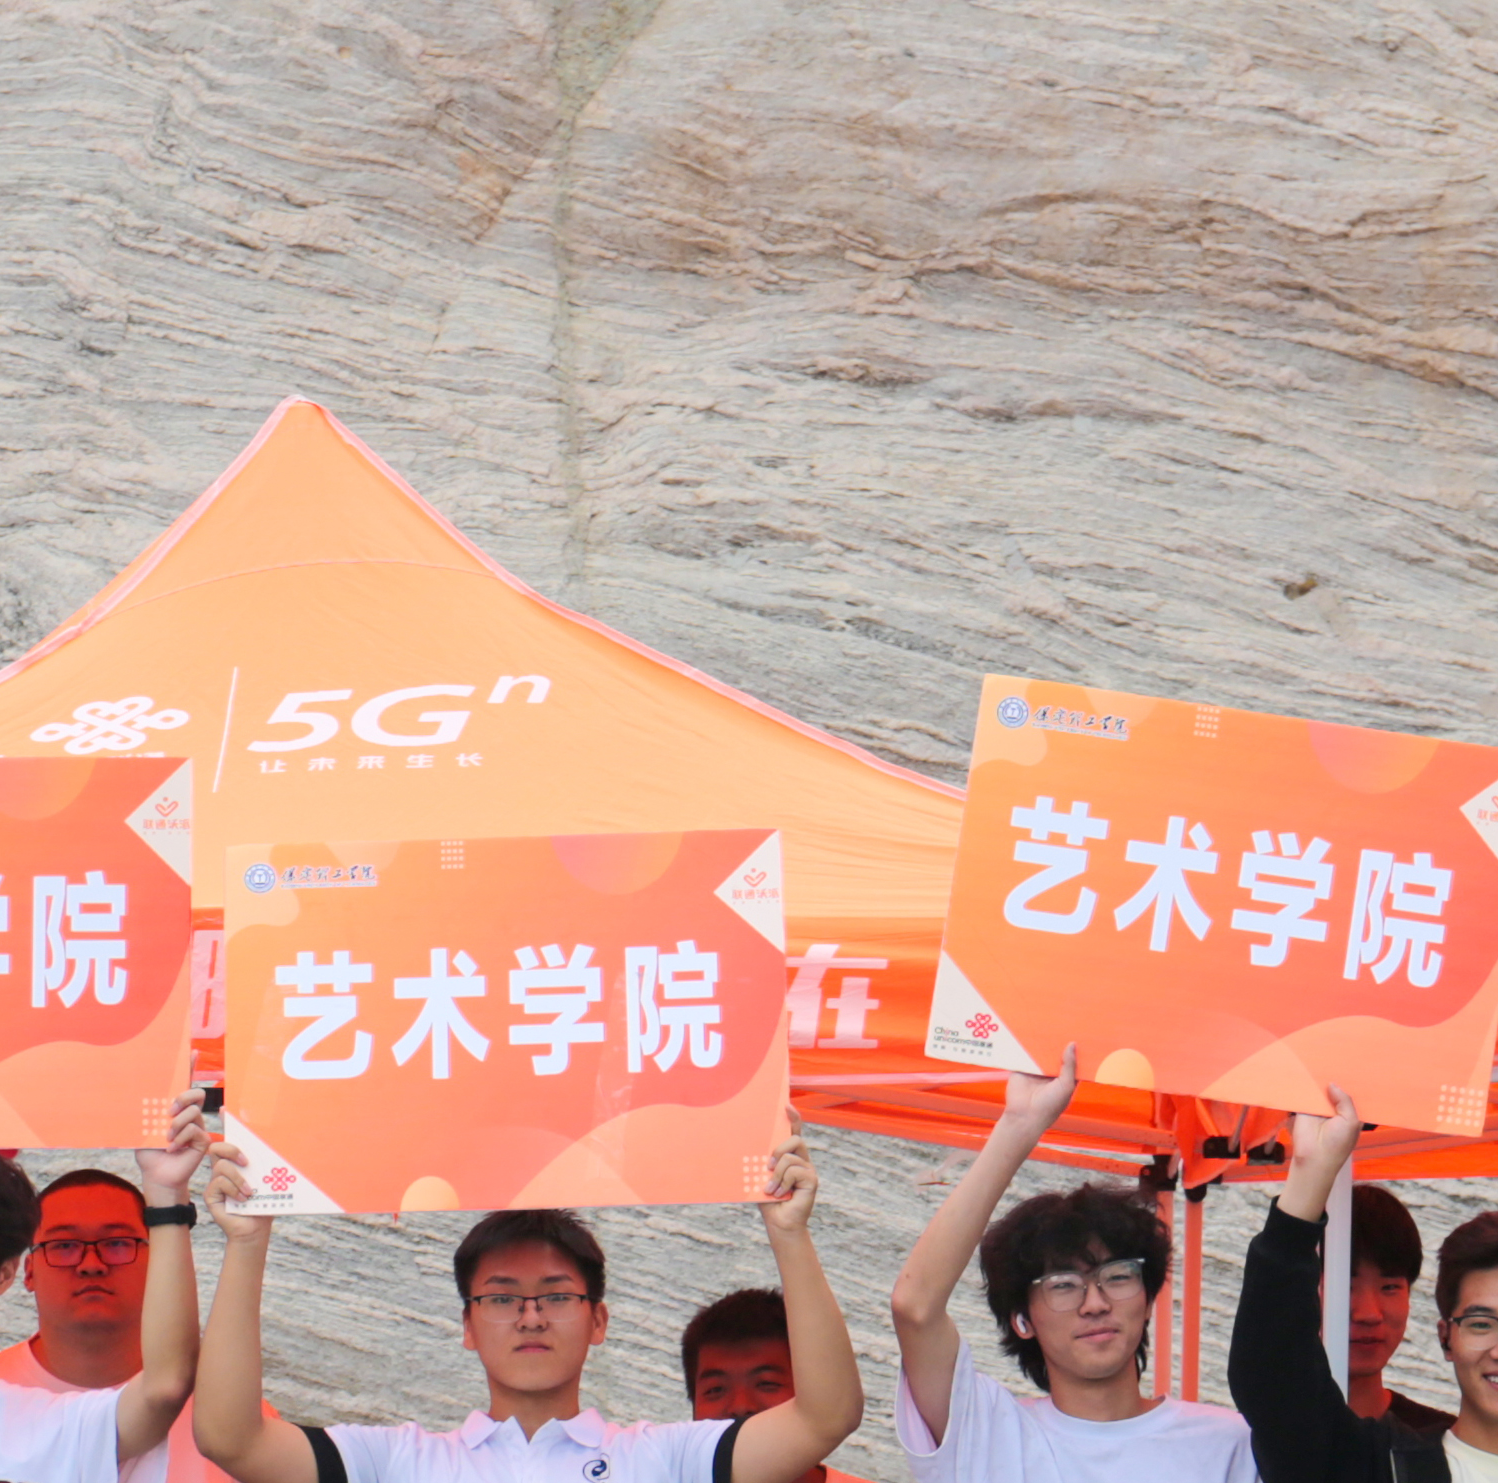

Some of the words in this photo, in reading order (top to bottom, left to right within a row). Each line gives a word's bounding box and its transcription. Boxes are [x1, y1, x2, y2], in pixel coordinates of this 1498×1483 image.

[258, 752, 483, 774] 让未来生长
[1003, 796, 1453, 988] 艺术学院
[275, 940, 722, 1080] 艺术学院
